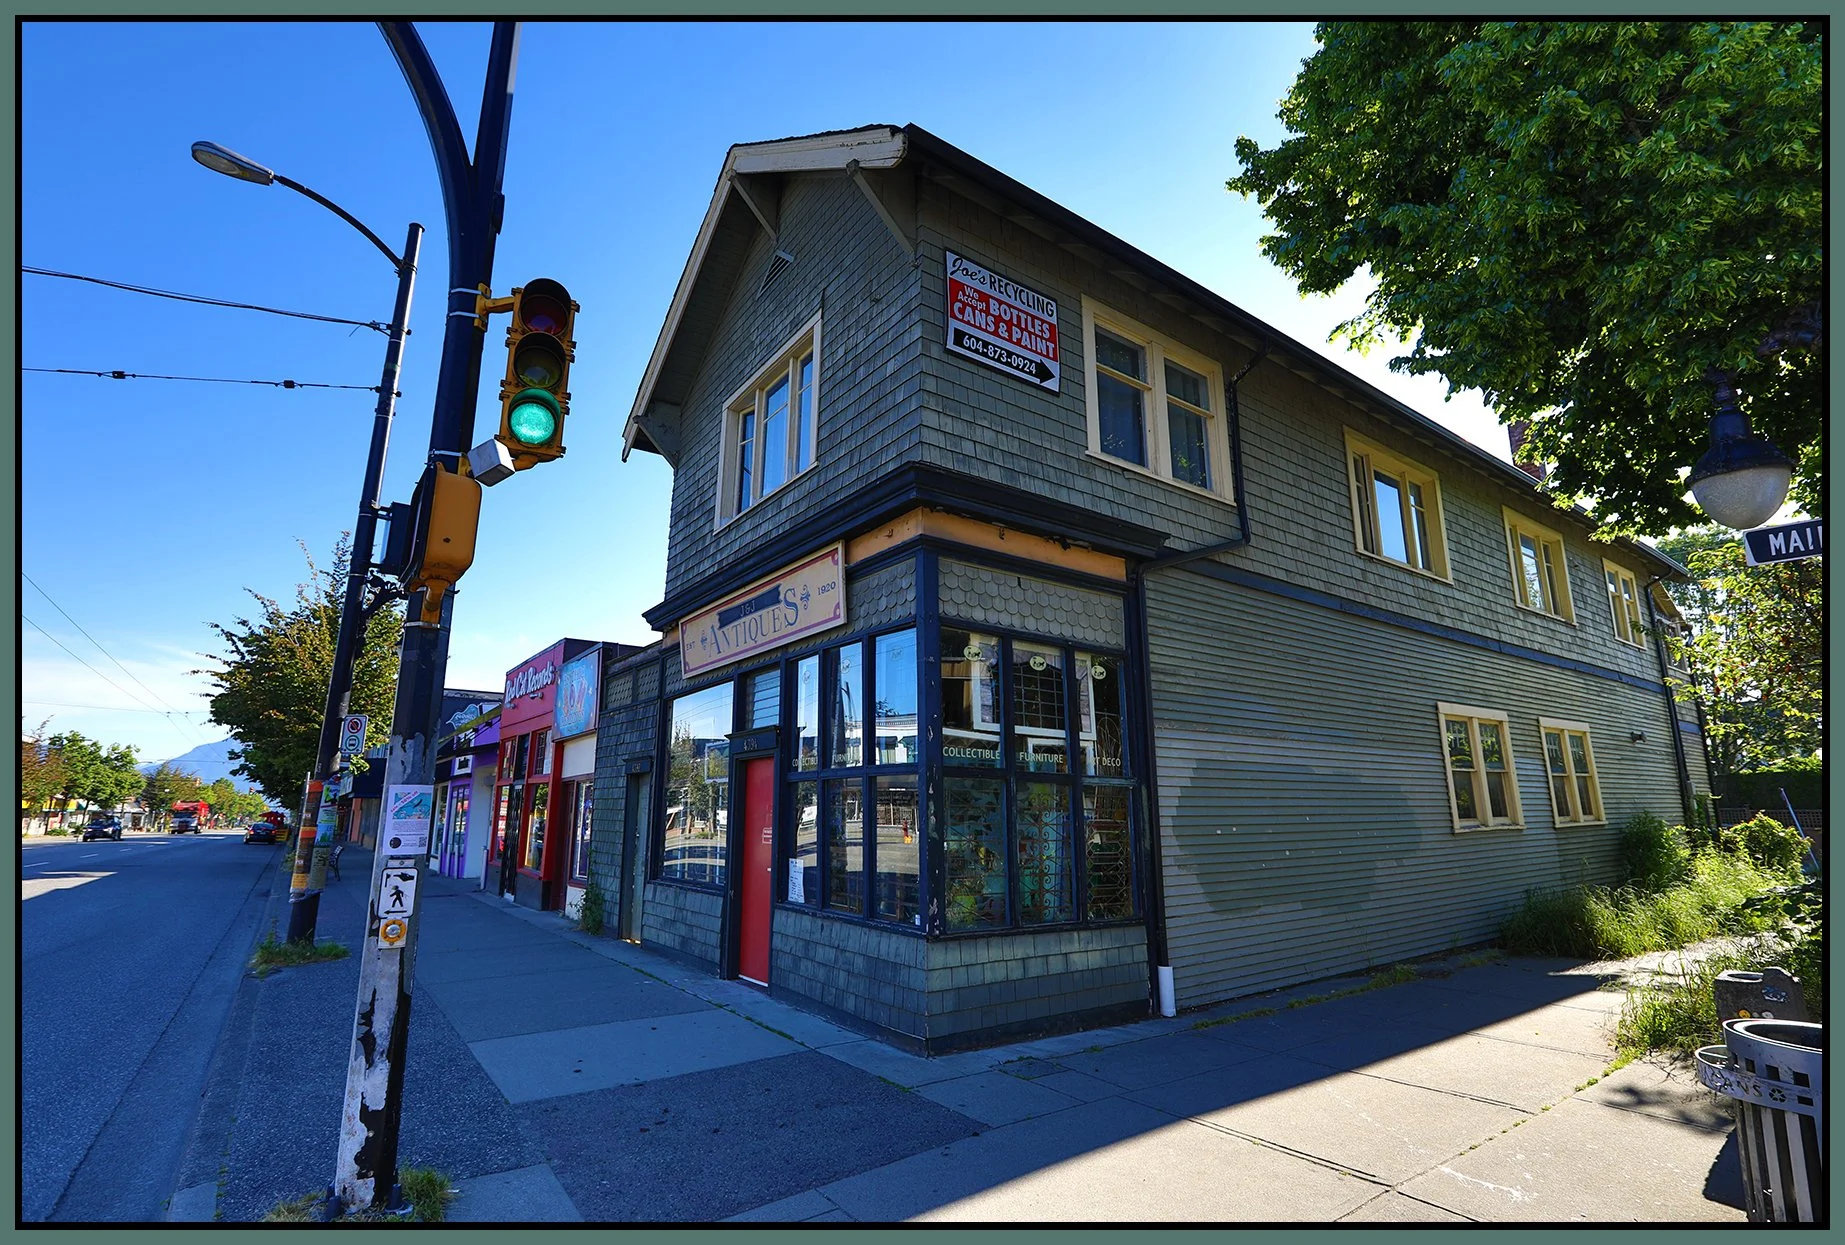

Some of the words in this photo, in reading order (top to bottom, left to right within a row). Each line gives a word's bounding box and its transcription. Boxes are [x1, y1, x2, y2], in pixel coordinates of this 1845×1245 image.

[950, 257, 987, 285] Joe's
[989, 274, 1054, 317] RECYCLING
[964, 285, 979, 300] We
[953, 302, 995, 331] CANS
[998, 322, 1009, 339] &
[1012, 326, 1055, 359] PAINT
[958, 291, 986, 310] Accept
[990, 298, 1050, 339] BOTTLES
[963, 335, 1037, 374] 604-873-0924
[1768, 525, 1822, 556] MAI
[817, 581, 836, 596] 1920
[708, 587, 799, 658] ANTIQUES
[1019, 751, 1063, 764] FURNITURE
[1102, 757, 1122, 767] DECO
